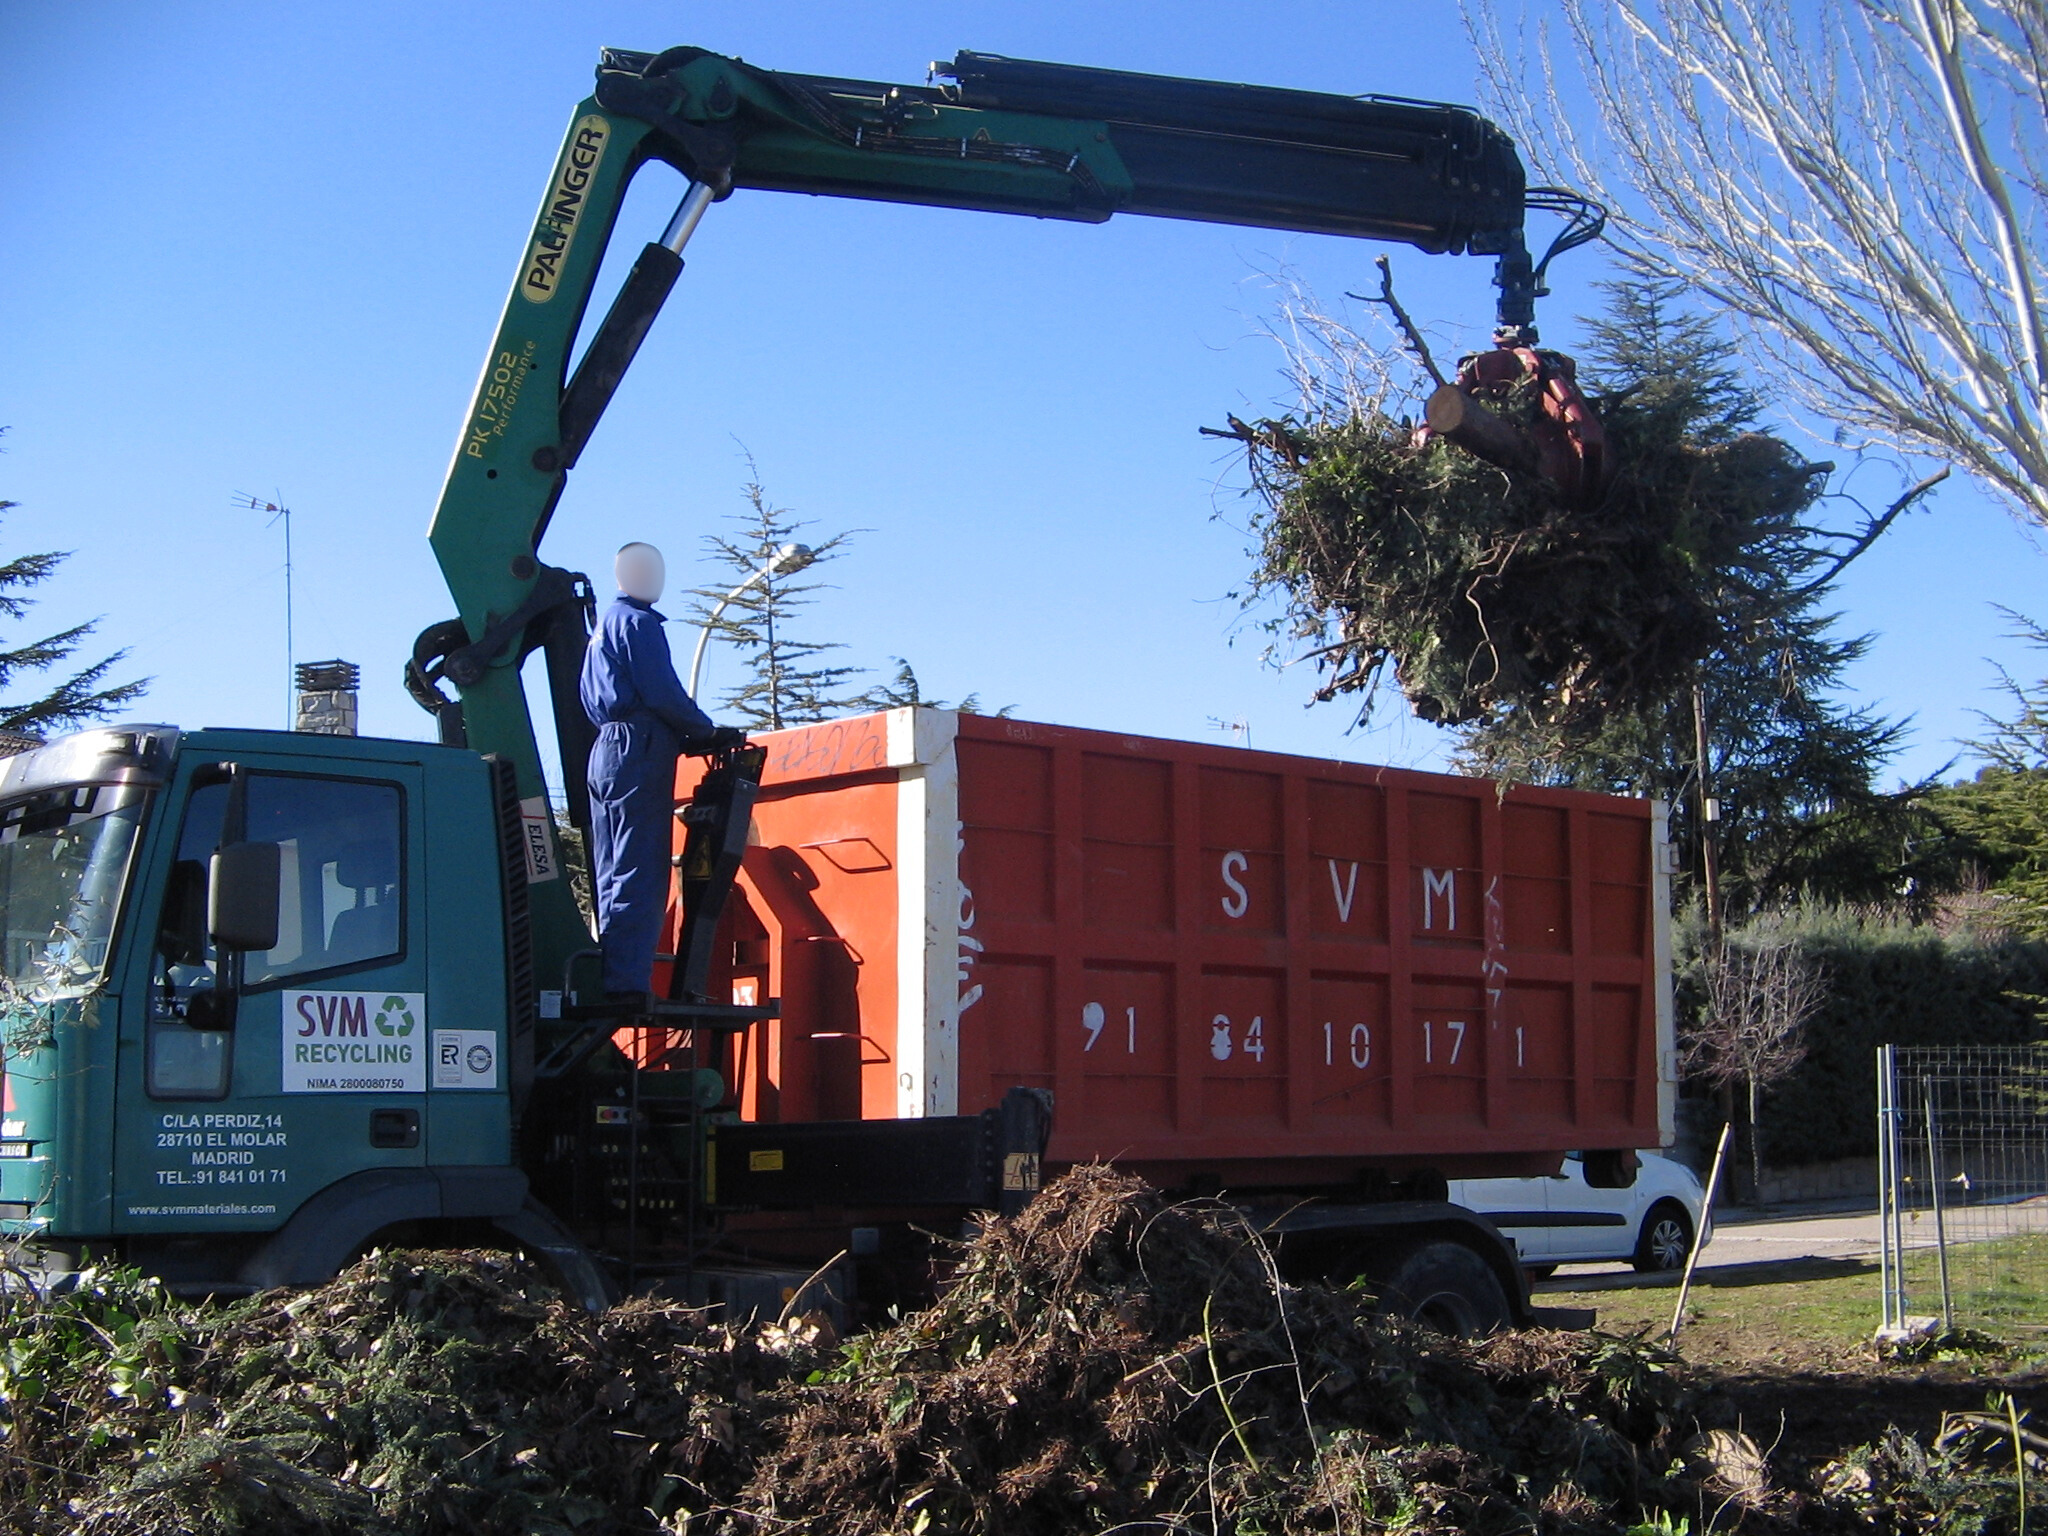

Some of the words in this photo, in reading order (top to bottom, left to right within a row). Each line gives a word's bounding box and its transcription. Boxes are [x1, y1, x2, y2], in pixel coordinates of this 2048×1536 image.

[527, 127, 604, 291] PALFINGER
[492, 340, 537, 437] Performance
[467, 426, 491, 459] PK
[480, 351, 518, 421] 17502
[528, 823, 550, 875] ELESA
[297, 995, 368, 1037] SVM
[295, 1043, 412, 1063] RECYCLING
[307, 1078, 337, 1089] NIMA
[340, 1078, 404, 1089] 2800080750
[162, 1114, 200, 1128] C/LA
[204, 1114, 282, 1130] PERDIZ,14
[157, 1133, 202, 1147] 28710
[206, 1133, 227, 1146] EL
[230, 1133, 288, 1146] MOLAR
[191, 1151, 254, 1165] MADRID
[218, 1170, 245, 1183] 841
[248, 1170, 265, 1183] 01
[270, 1169, 287, 1183] 71
[128, 1203, 276, 1216] www.svmmateriales.com
